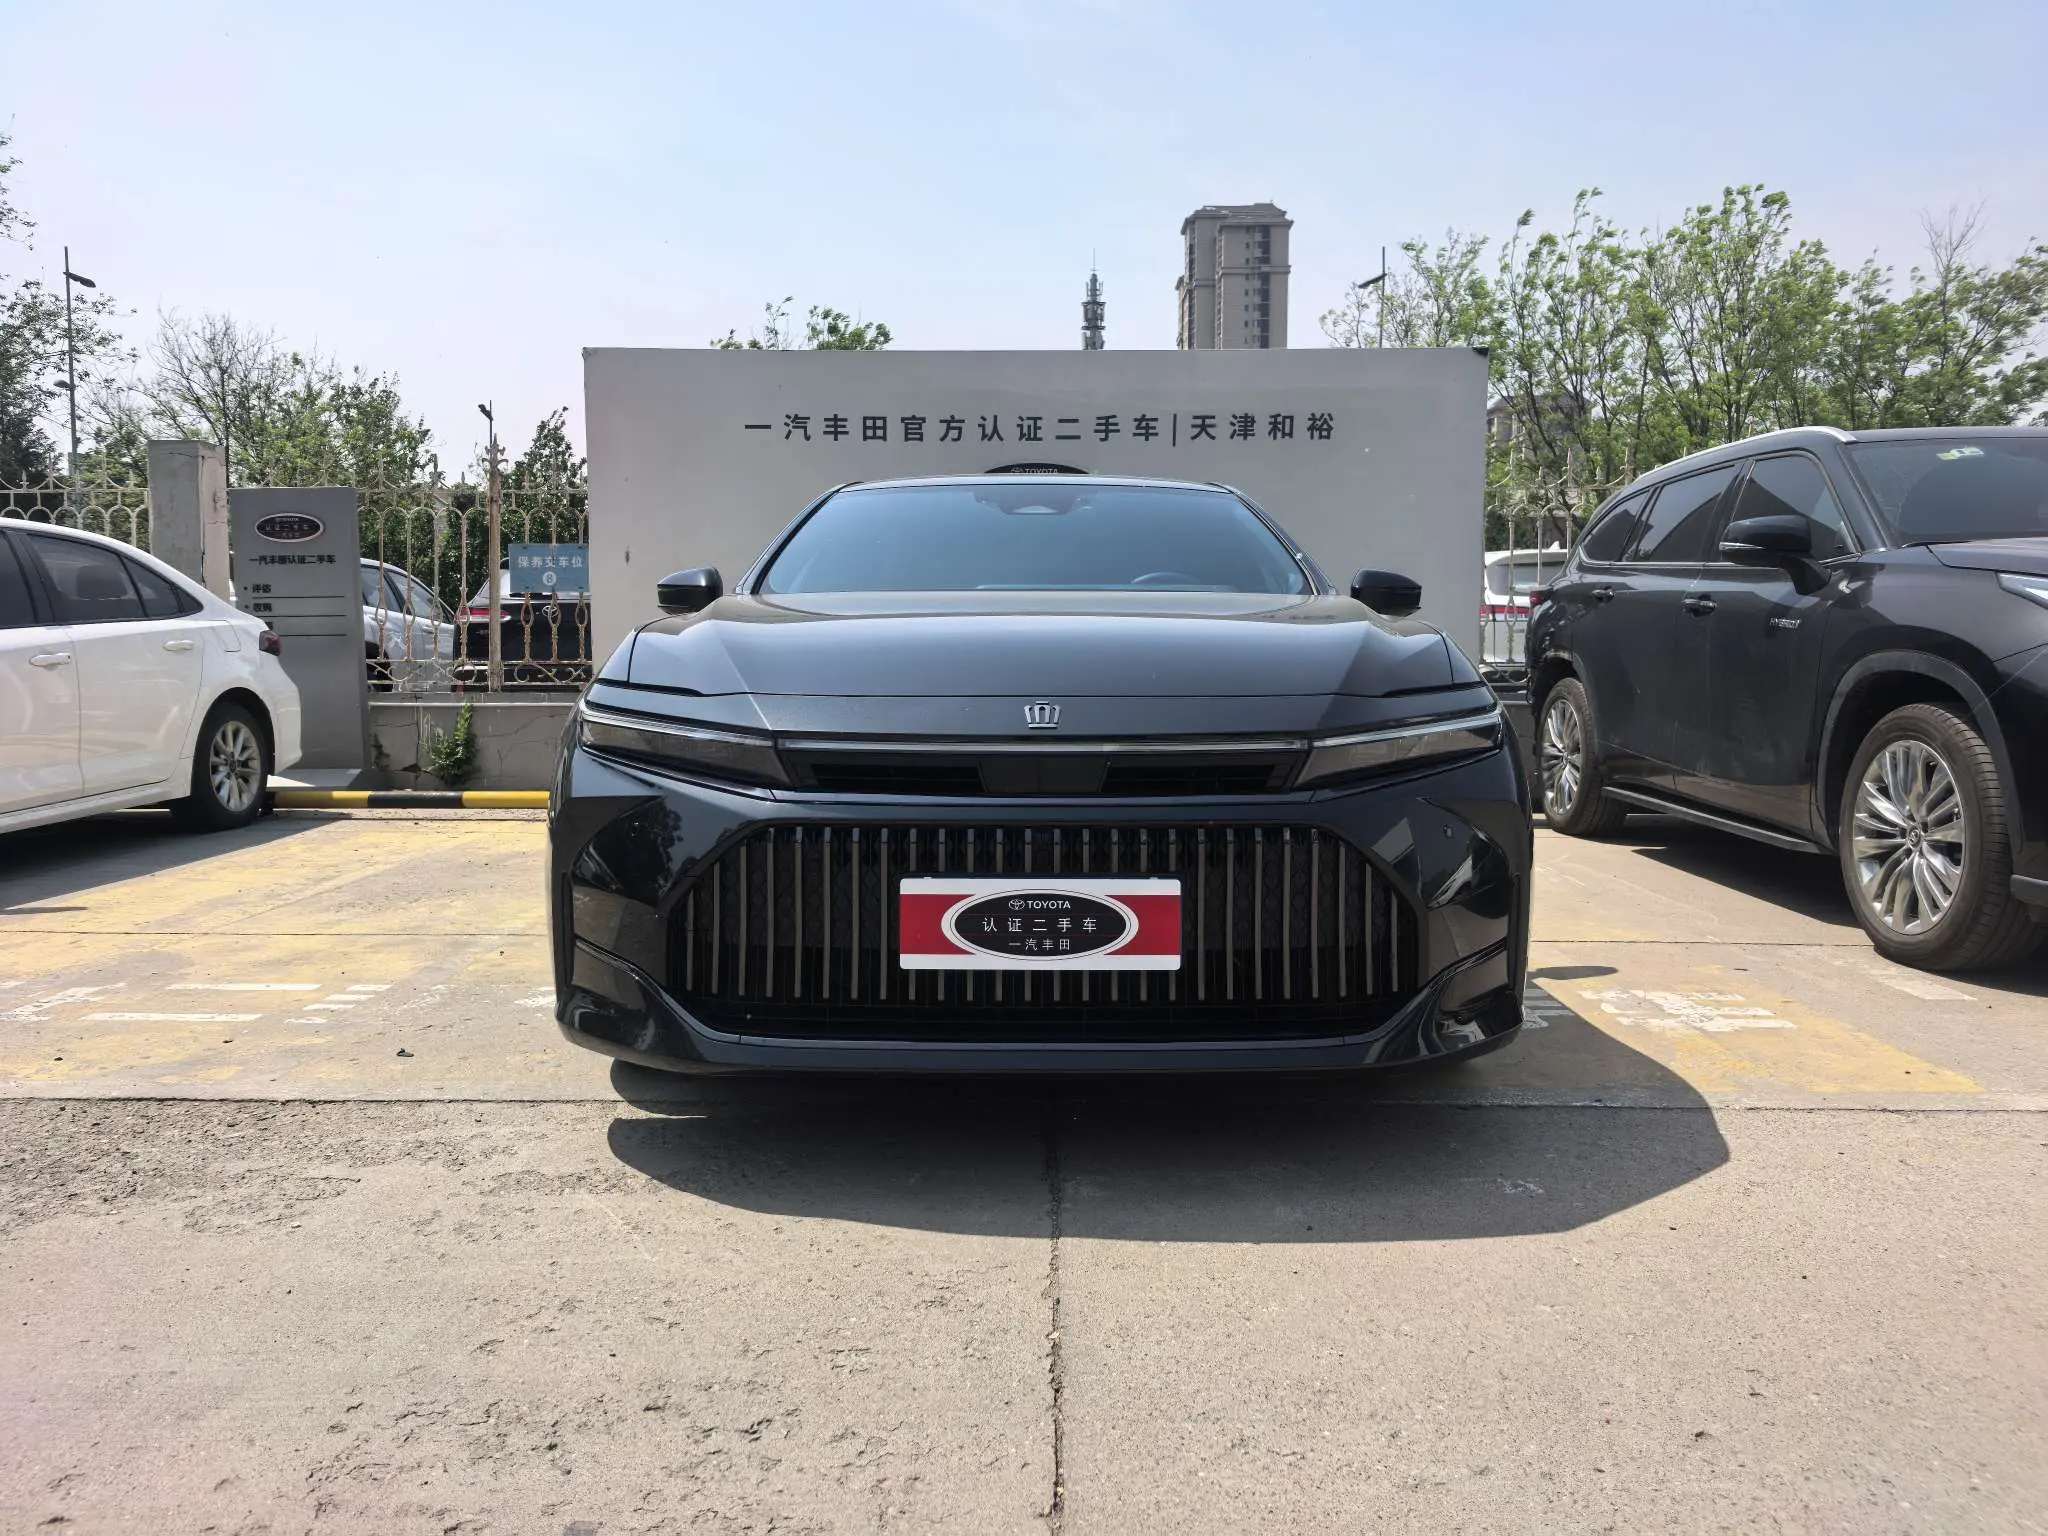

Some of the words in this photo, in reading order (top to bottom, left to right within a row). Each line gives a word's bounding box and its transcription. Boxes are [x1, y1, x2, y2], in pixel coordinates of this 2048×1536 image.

[744, 413, 1335, 447] 一汽丰田官方认证二手车|天津和裕
[1027, 900, 1071, 909] TOYOTA
[982, 917, 1097, 933] 认证二手车
[1008, 939, 1070, 951] 一汽丰田
